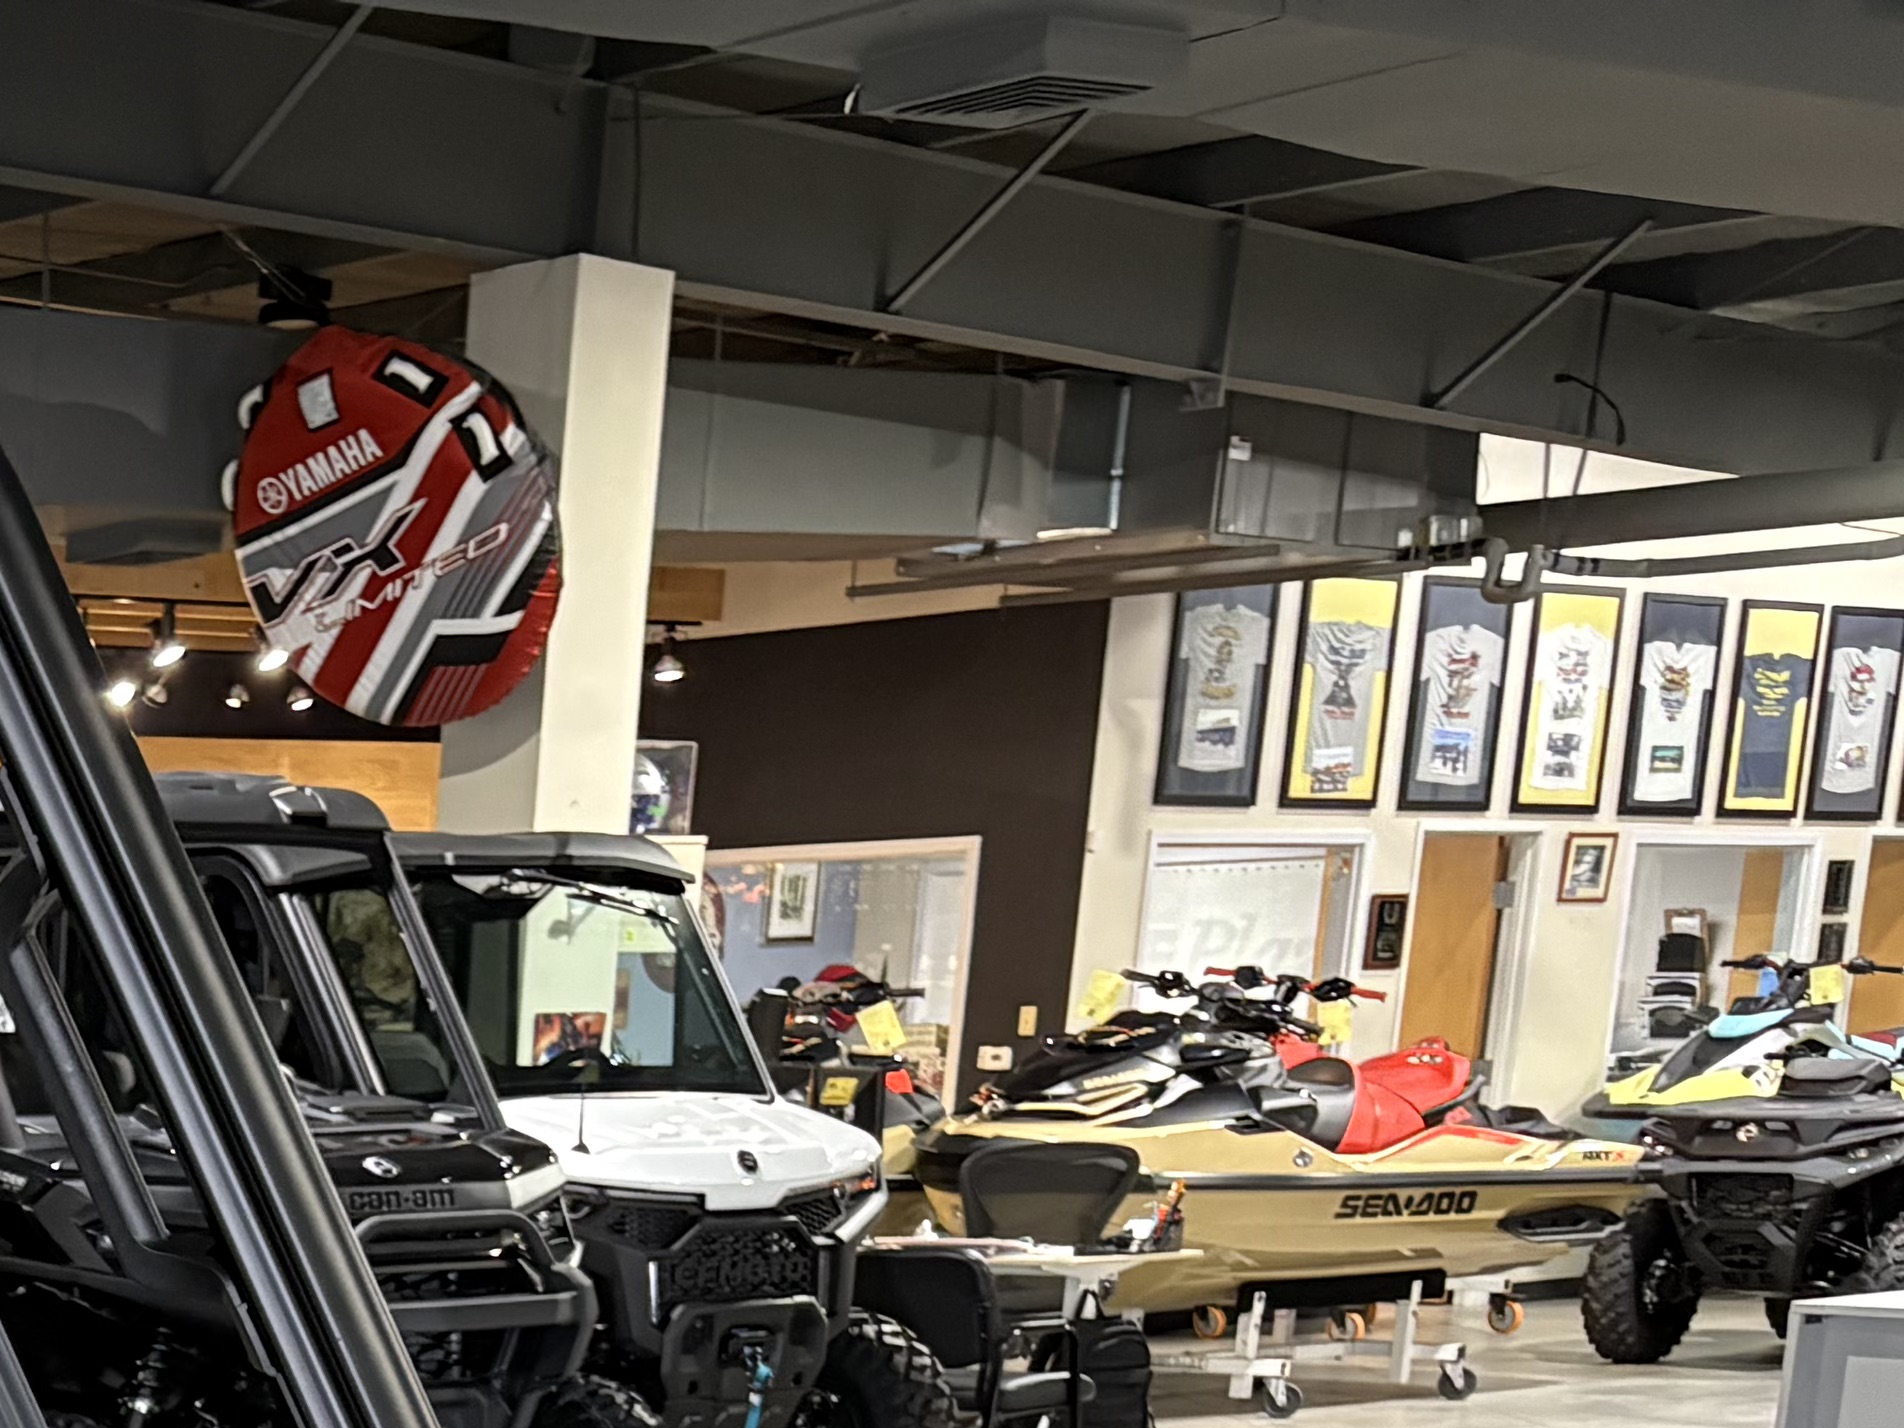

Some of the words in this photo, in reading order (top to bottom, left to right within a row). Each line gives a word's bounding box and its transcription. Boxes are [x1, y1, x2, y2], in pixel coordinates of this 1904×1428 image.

[278, 428, 384, 501] YAMAHA
[244, 497, 429, 629] VX
[313, 521, 510, 633] LIMITED
